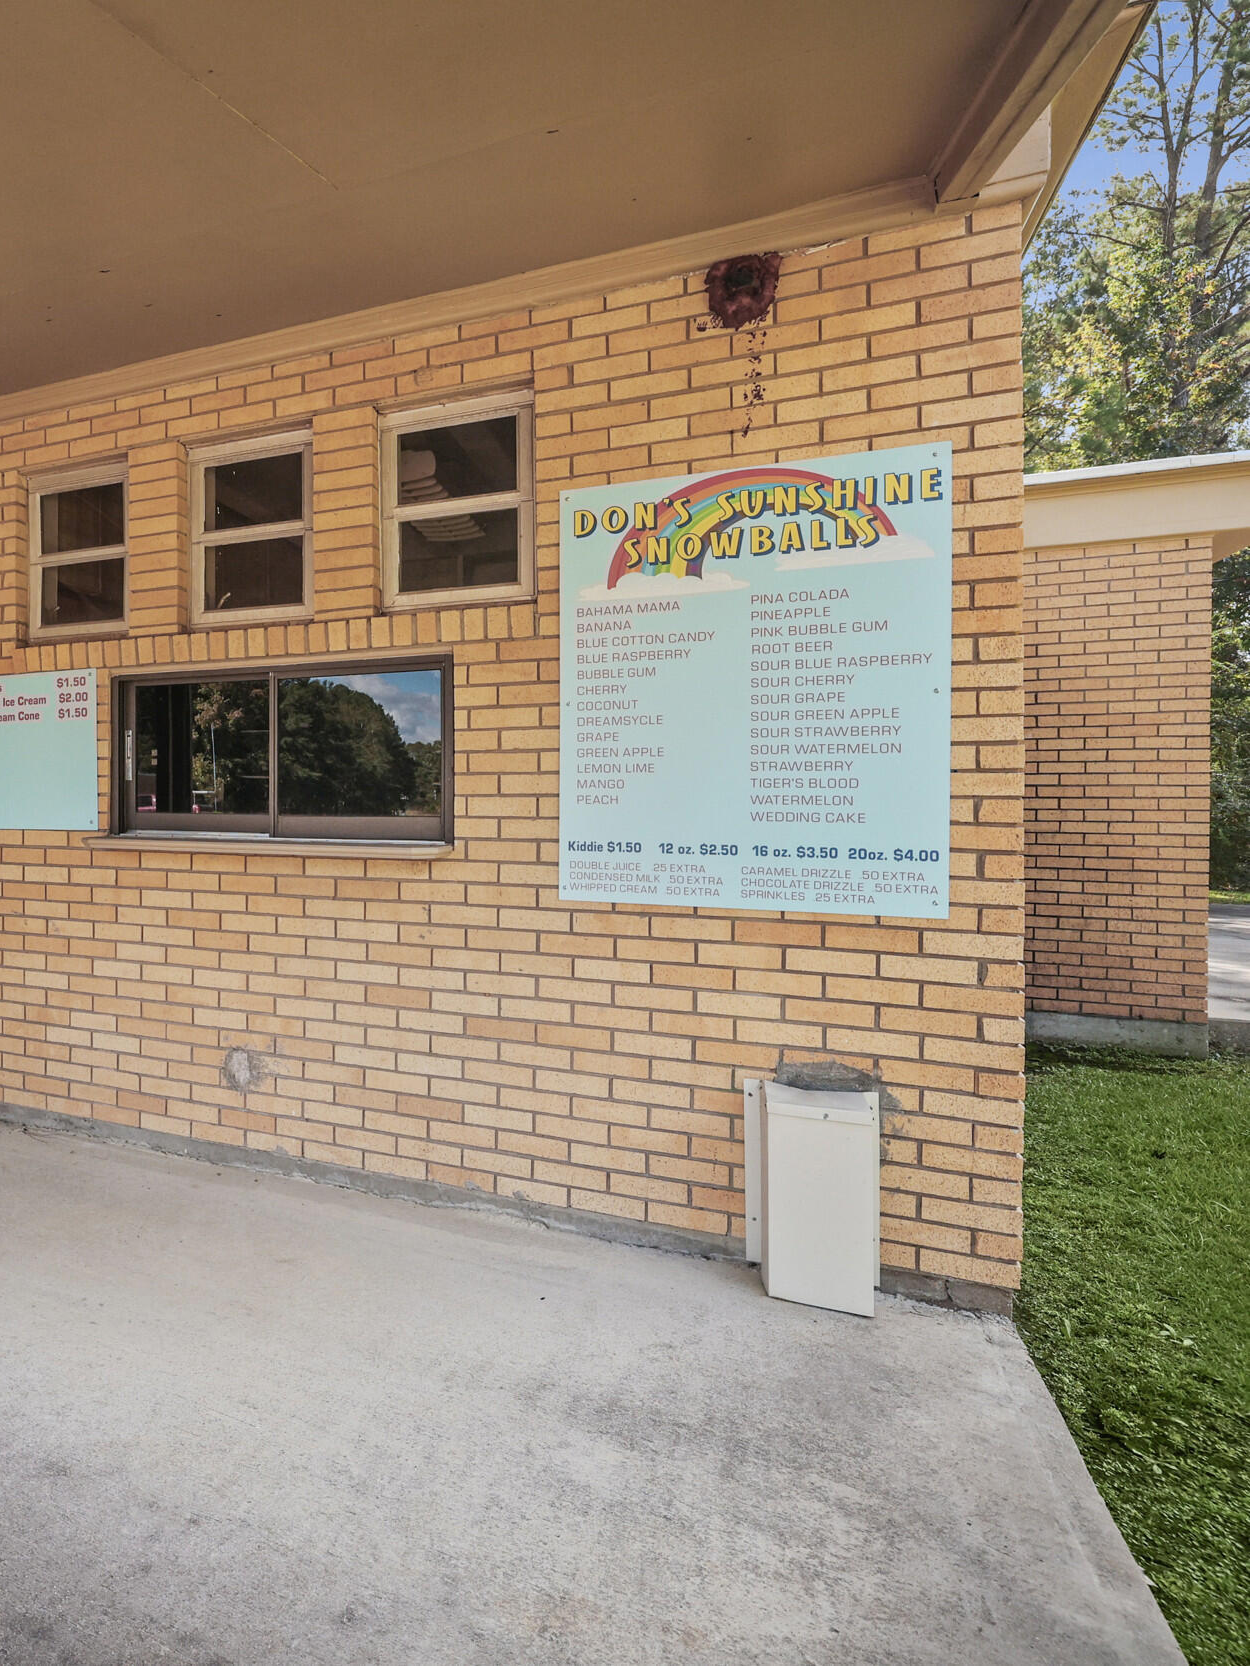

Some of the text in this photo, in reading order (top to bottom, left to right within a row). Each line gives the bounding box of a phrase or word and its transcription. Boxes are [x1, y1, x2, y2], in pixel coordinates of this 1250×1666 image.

[574, 468, 943, 539] DON'S SUNSHINE
[623, 514, 880, 568] SNOWBALLS
[750, 588, 850, 605] PINA COLADA
[576, 601, 680, 618] BAHAMA MAMA
[750, 607, 830, 621] PINEAPPLE
[576, 620, 632, 633] BANANA
[750, 620, 888, 638] PINK BUBBLE GUM
[576, 631, 715, 649] BLUE COTTON CANDY
[751, 640, 833, 654] ROOT BEER
[577, 649, 691, 664] BLUE RASPBERRY
[750, 653, 932, 672] SOUR BLUE RASPBERRY
[577, 667, 656, 680] BUBBLE GUM
[57, 676, 86, 688] $1.50
[750, 674, 854, 688] SOUR CHERRY
[577, 685, 627, 695] CHERRY
[3, 697, 15, 707] Ice
[18, 695, 46, 706] Cream
[59, 692, 88, 703] $2.00
[750, 692, 845, 705] SOUR GRAPE
[576, 700, 638, 711] COCONUT
[18, 711, 40, 721] Cone
[58, 708, 87, 719] $1.50
[577, 715, 663, 727] DREAMSYCLE
[750, 708, 899, 721] SOUR GREEN APPLE
[577, 732, 619, 742] GRAPE
[750, 726, 901, 738] SOUR STRAWBERRY
[577, 747, 664, 758] GREEN APPLE
[750, 743, 902, 755] SOUR WATERMELON
[577, 763, 654, 773] LEMON LIME
[750, 761, 853, 772] STRAWBERRY
[577, 779, 625, 789] MANGO
[750, 778, 859, 789] TIGER'S BLOOD
[577, 795, 619, 805] PEACH
[750, 795, 853, 806] WATERMELON
[750, 812, 866, 823] WEDDING CAKE
[568, 841, 939, 862] Kiddie $1.50 12 oz. $2.50 16 oz. $3.50 20oz. $4.00
[569, 860, 609, 870] DOUBLE
[613, 863, 641, 871] JUICE
[670, 864, 706, 873] EXTRA
[569, 872, 632, 882] CONDENSED
[636, 874, 660, 883] MILK
[687, 876, 723, 886] EXTRA
[741, 867, 798, 877] CARAMEL
[802, 868, 851, 879] DRIZZLE
[883, 871, 925, 882] EXTRA
[569, 882, 616, 892] WHIPPED
[620, 885, 658, 894] CREAM
[683, 887, 720, 897] EXTRA
[741, 878, 809, 889] CHOCOLATE
[814, 881, 864, 892] DRIZZLE
[896, 883, 938, 894] EXTRA
[741, 890, 805, 901] SPRINKLES
[835, 893, 875, 904] EXTRA
